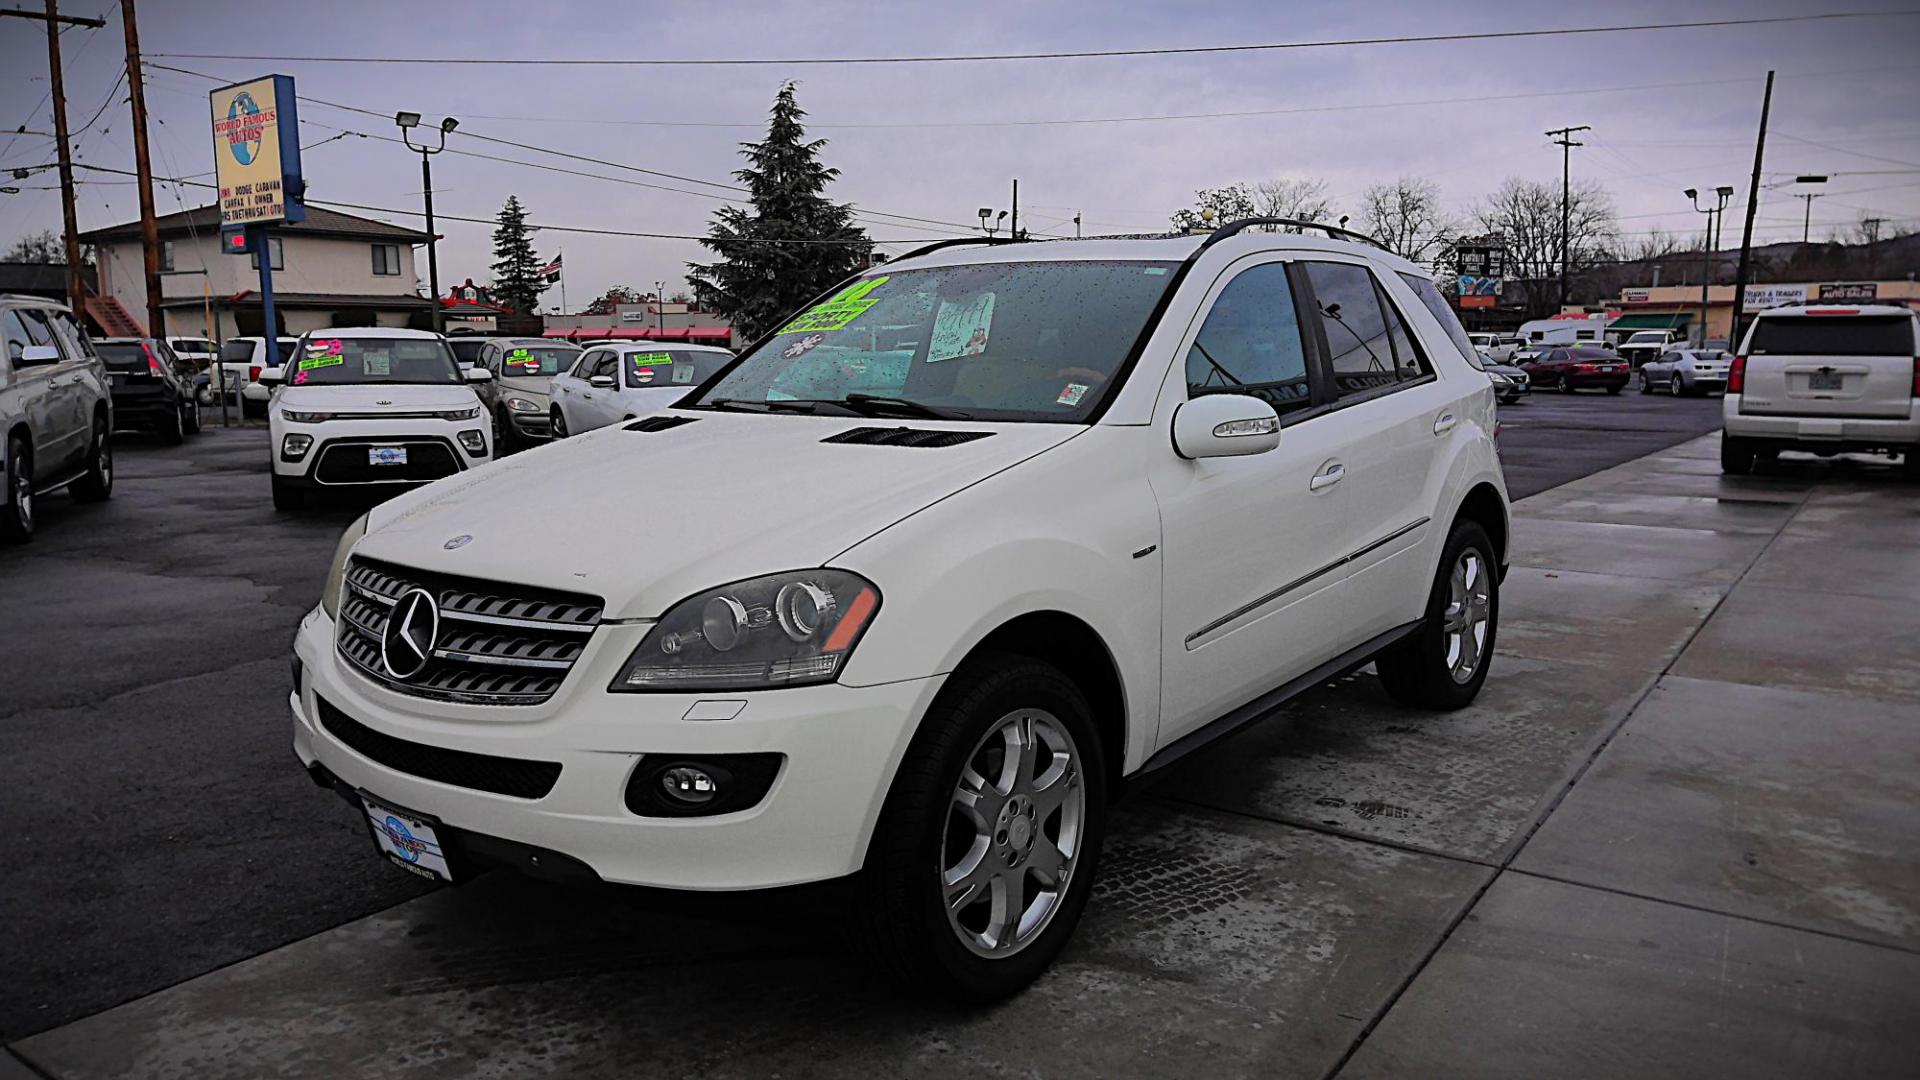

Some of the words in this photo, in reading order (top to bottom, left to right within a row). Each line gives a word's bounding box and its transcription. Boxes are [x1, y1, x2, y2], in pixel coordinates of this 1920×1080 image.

[215, 118, 242, 133] WORLD
[243, 110, 276, 127] FAMOUS
[235, 184, 252, 196] DODGE
[255, 180, 280, 193] CARAVAN
[254, 193, 273, 205] OWNER
[1823, 289, 1845, 298] AUTO
